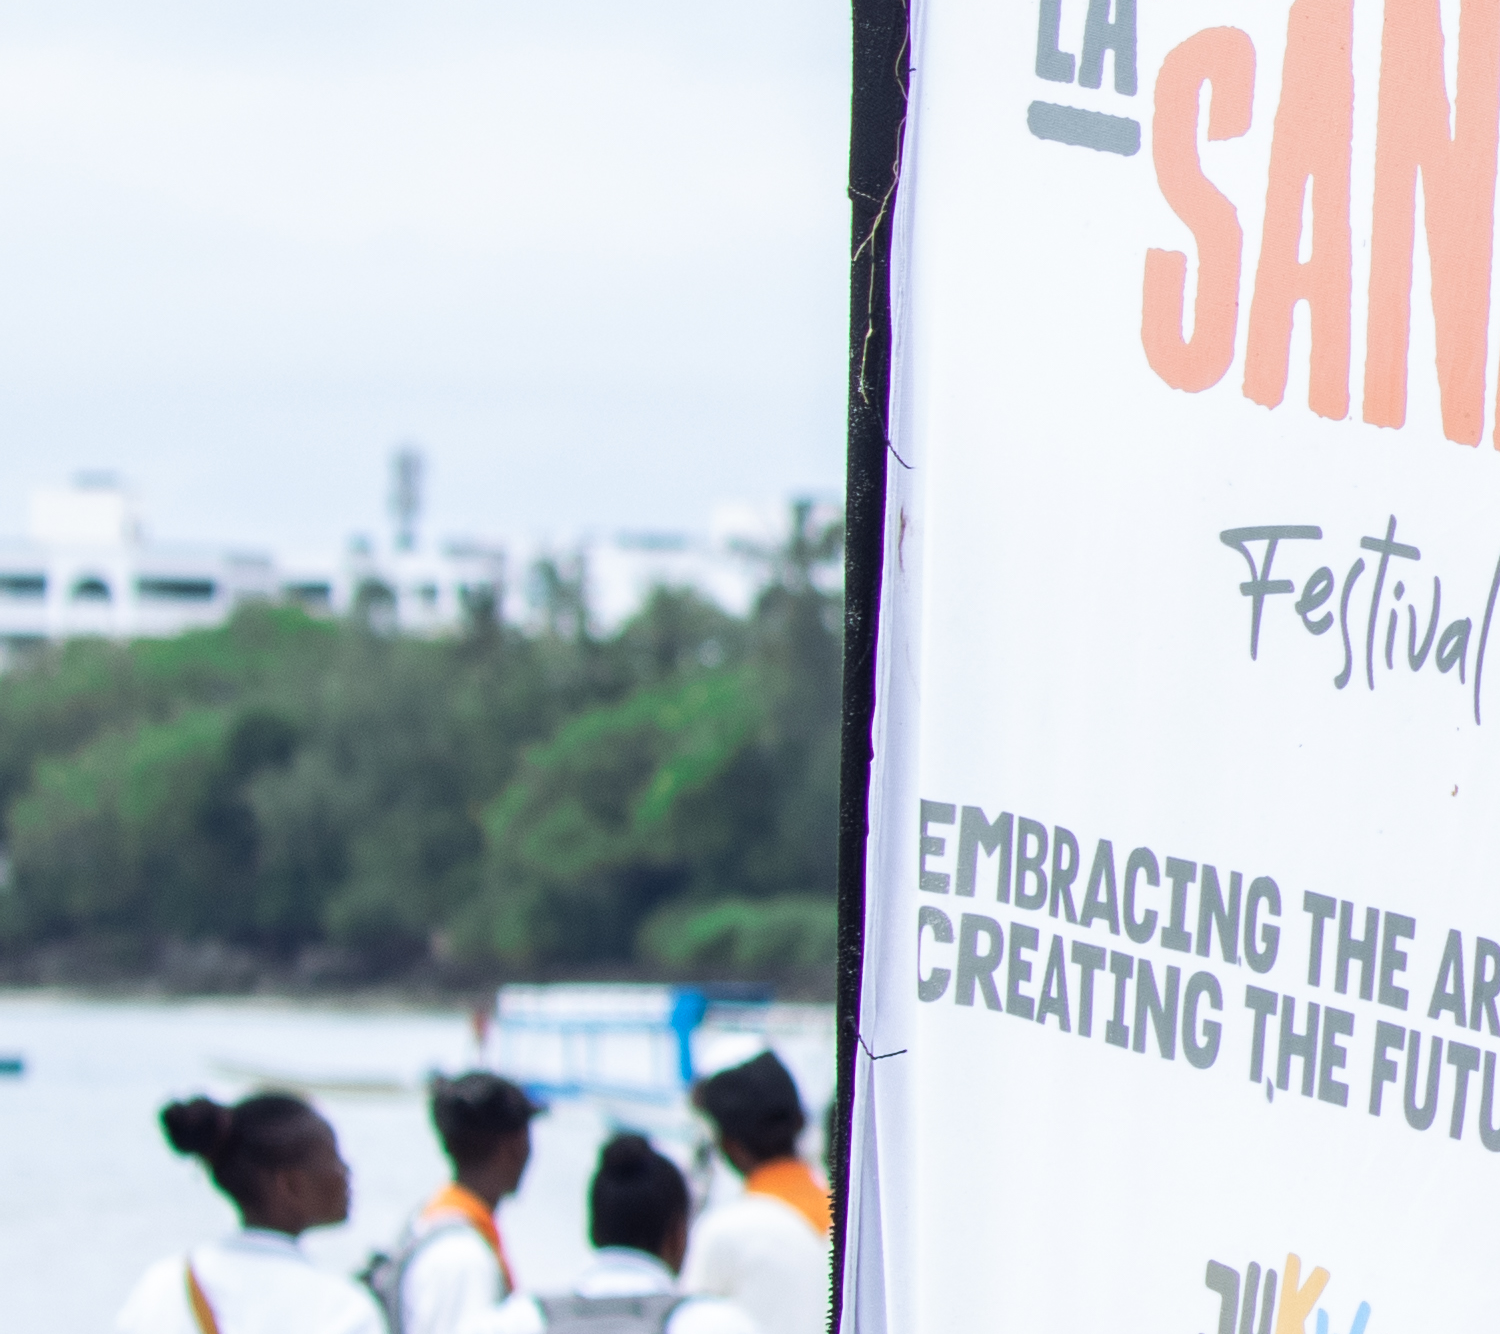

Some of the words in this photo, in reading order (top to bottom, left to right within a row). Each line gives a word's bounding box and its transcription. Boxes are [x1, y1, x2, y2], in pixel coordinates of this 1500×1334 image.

[917, 905, 1223, 1070] CREATING
[1244, 984, 1355, 1108] THE
[918, 798, 1281, 975] EMBRACING
[1303, 889, 1416, 1012] THE
